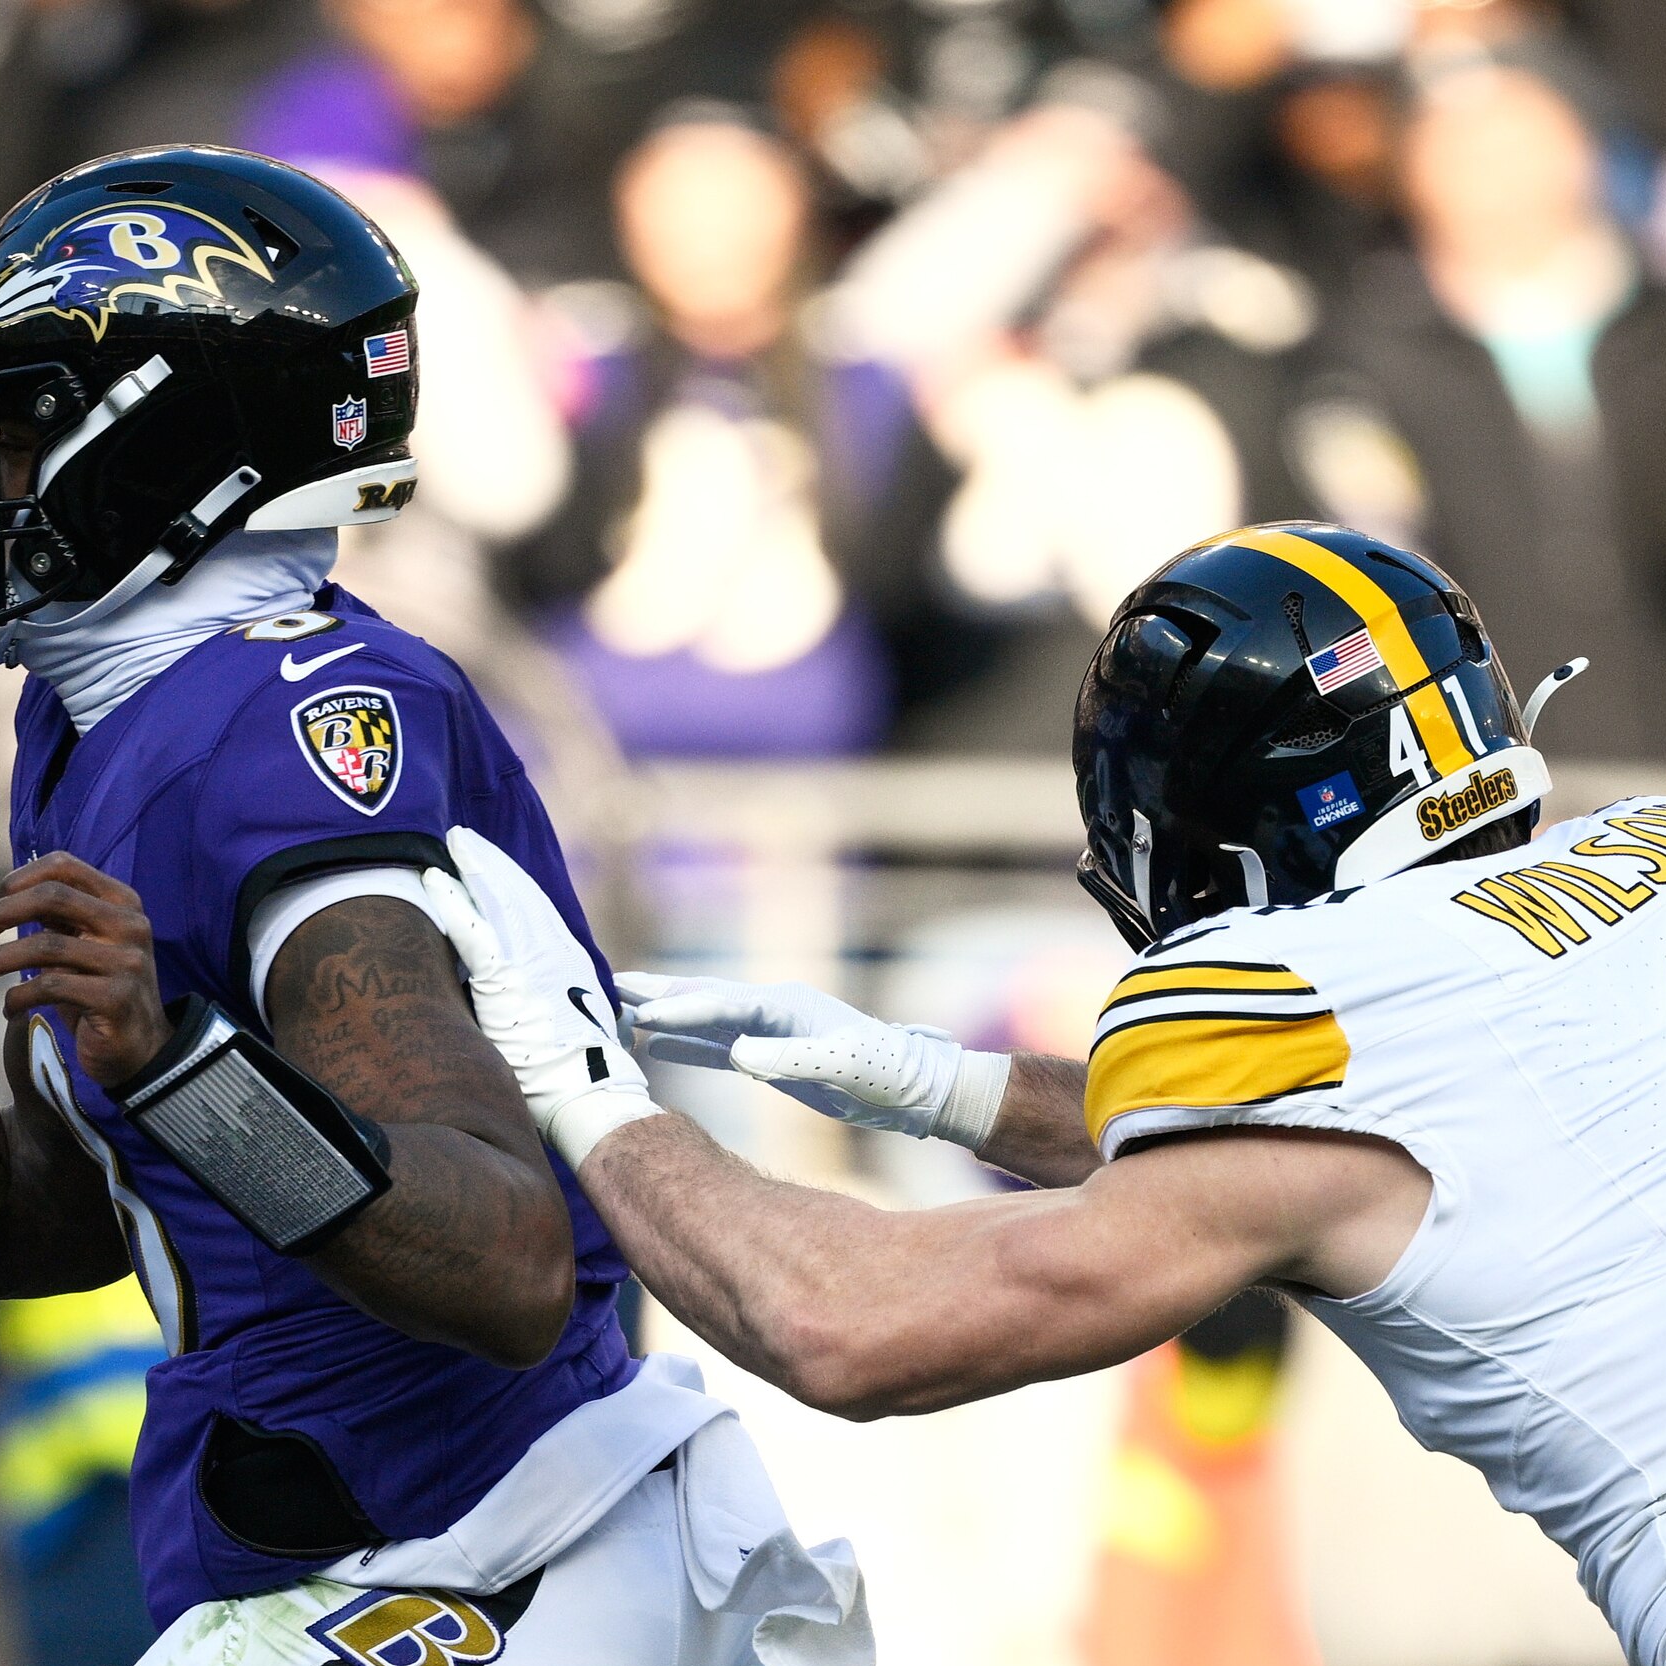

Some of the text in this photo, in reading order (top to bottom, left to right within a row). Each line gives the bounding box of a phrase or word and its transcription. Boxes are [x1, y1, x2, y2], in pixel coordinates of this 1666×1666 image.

[337, 418, 363, 442] NFL
[302, 696, 383, 724] RAVENS
[1389, 674, 1489, 789] 41
[1313, 801, 1360, 827] CHANGE
[1317, 798, 1349, 816] INSPIRE
[1416, 767, 1519, 842] Steelers
